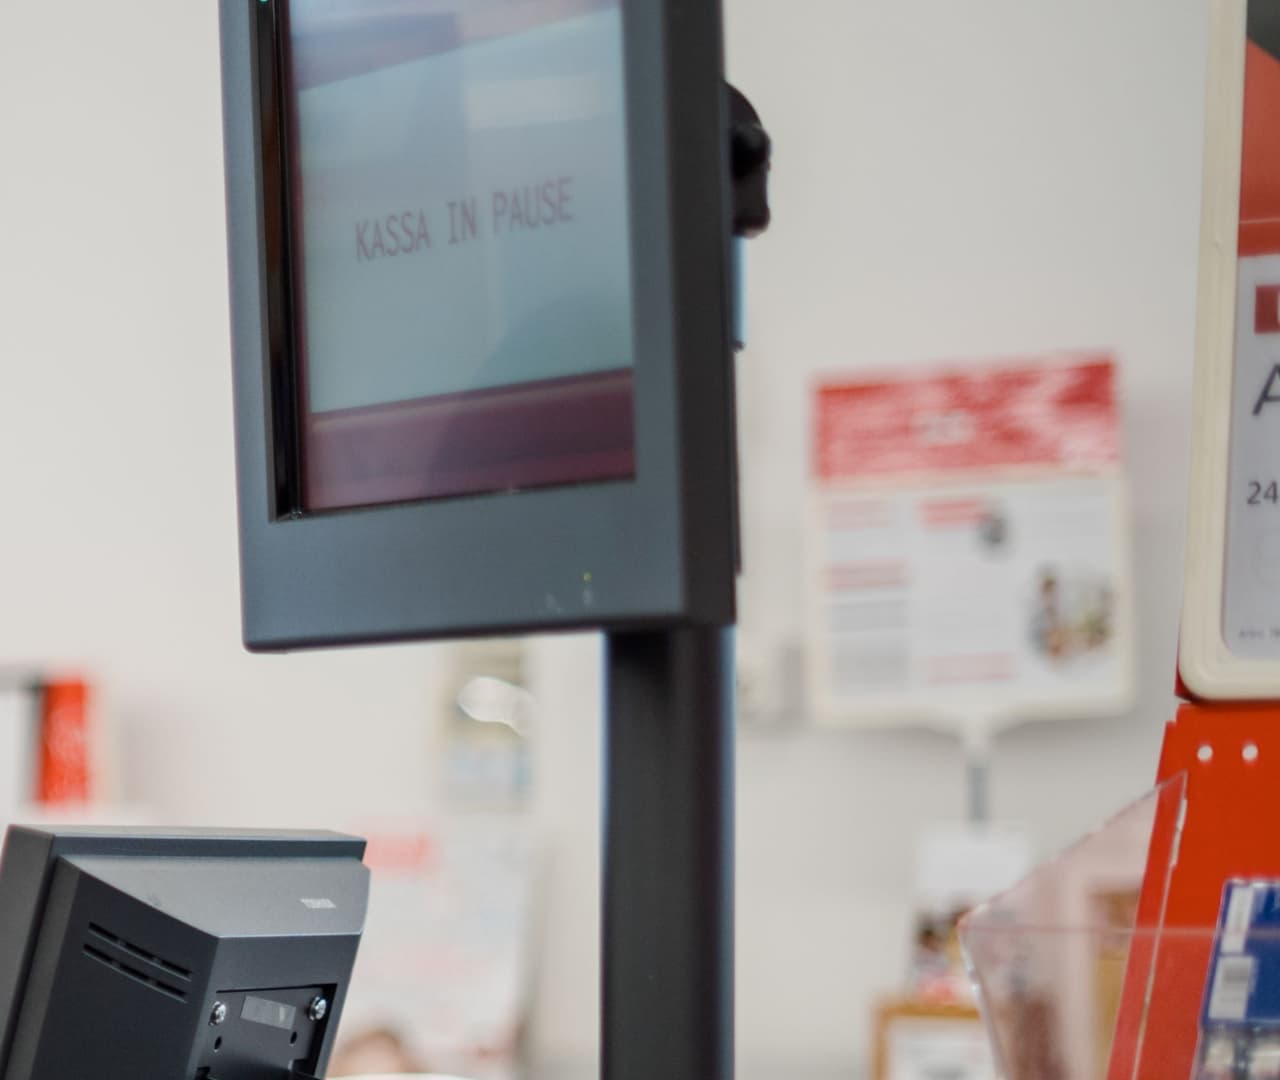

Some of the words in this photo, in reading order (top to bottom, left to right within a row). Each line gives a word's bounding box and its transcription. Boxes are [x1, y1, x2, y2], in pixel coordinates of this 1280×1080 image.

[354, 208, 432, 263] KASSA
[446, 195, 478, 245] IN
[491, 176, 575, 235] PAUSE
